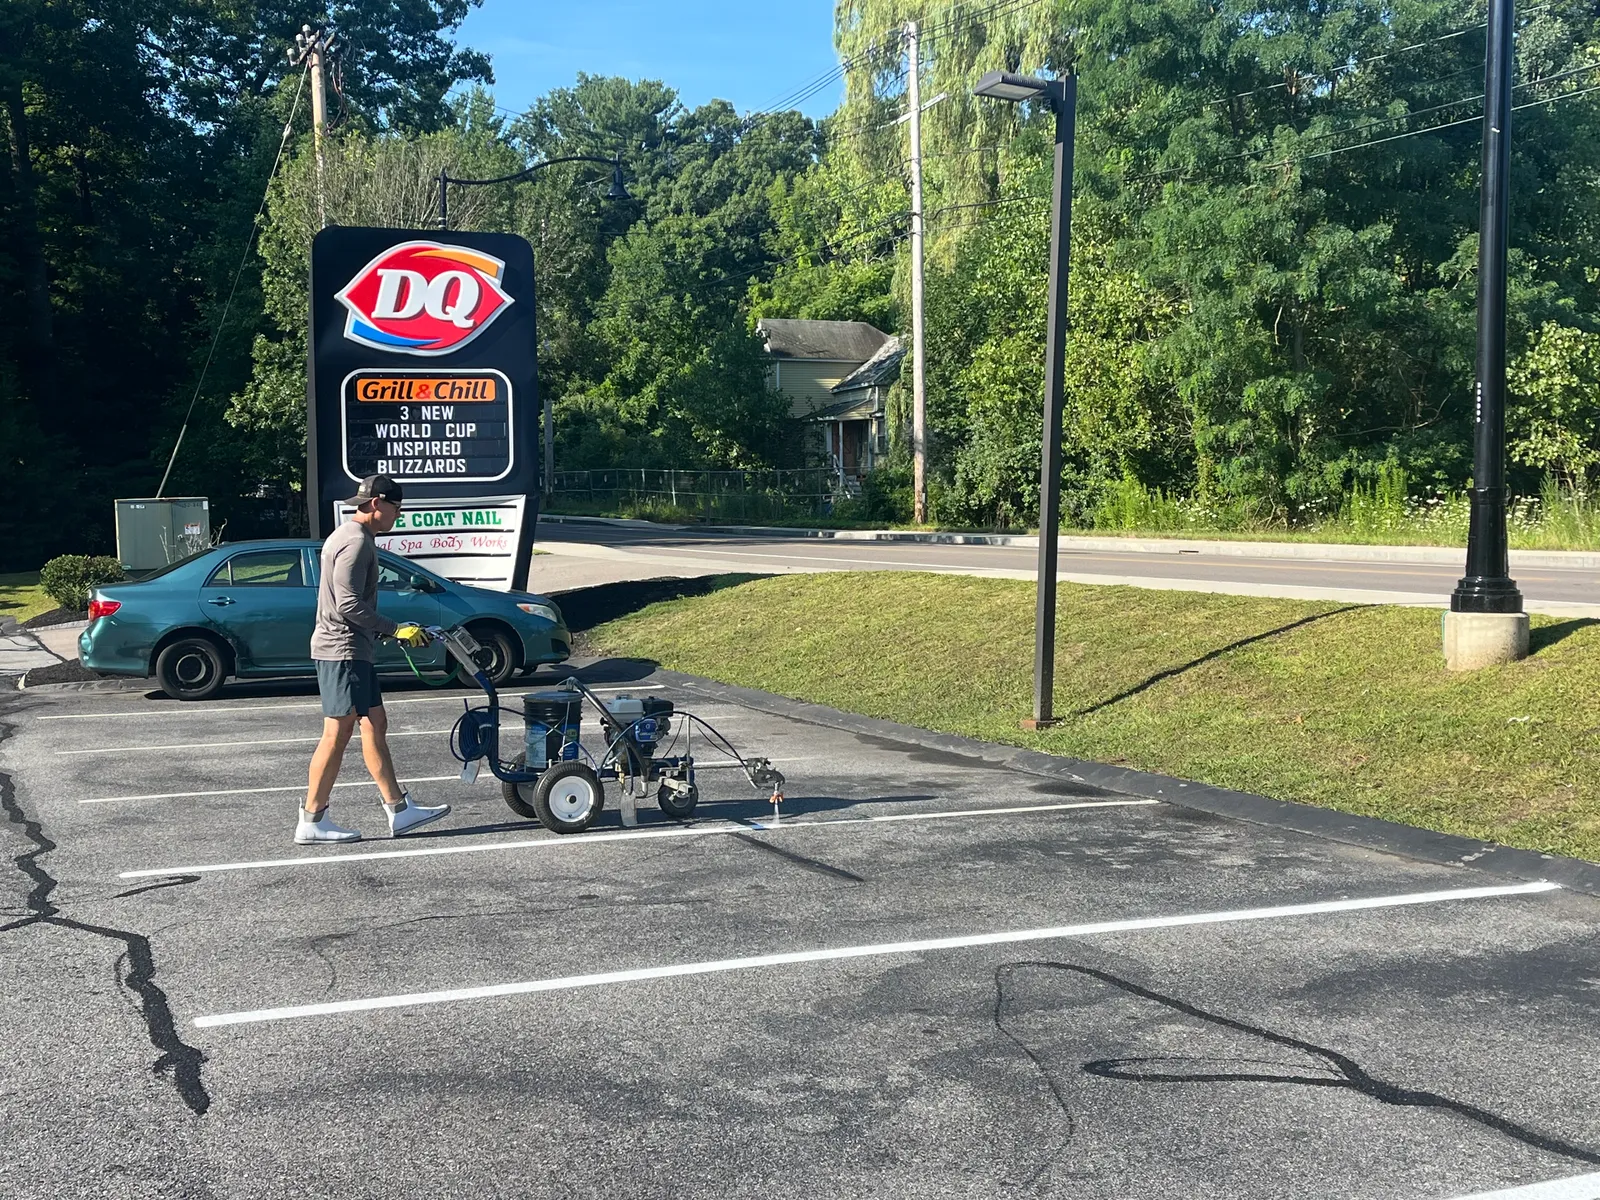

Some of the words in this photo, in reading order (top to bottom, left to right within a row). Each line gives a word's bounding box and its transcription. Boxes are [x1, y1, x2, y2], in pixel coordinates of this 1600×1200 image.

[371, 268, 480, 329] DQ
[400, 405, 409, 420] 3
[421, 405, 454, 420] NEW
[375, 423, 431, 438] WORLD
[445, 423, 476, 438] CUP
[386, 441, 461, 456] INSPIRED
[377, 459, 466, 474] BLIZZARDS
[412, 512, 455, 527] COAT
[462, 511, 502, 525] NAIL
[398, 539, 423, 553] Spa
[430, 536, 463, 551] Body
[470, 535, 508, 550] Works
